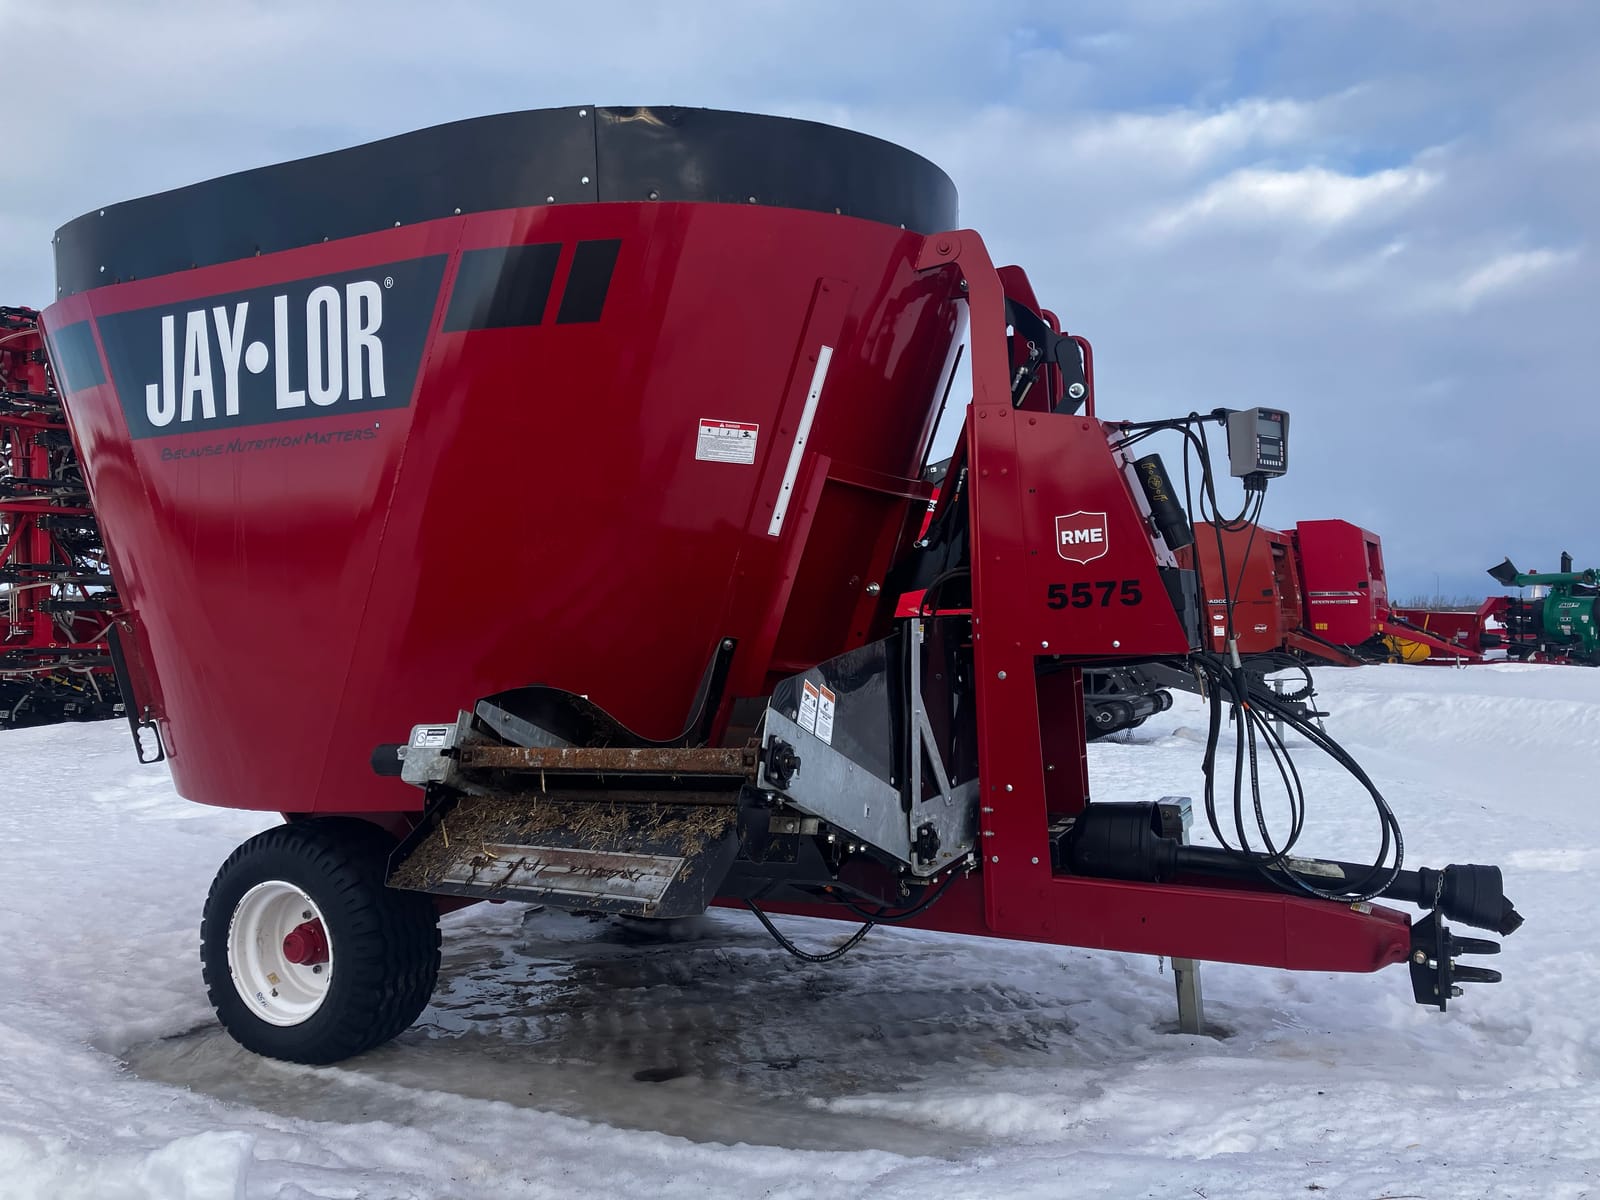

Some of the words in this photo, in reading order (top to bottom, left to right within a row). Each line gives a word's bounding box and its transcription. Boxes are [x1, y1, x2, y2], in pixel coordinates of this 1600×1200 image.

[161, 444, 223, 461] BECAUSE
[225, 435, 302, 454] NUTRITION
[1061, 528, 1103, 545] RME
[1047, 579, 1143, 610] 5575
